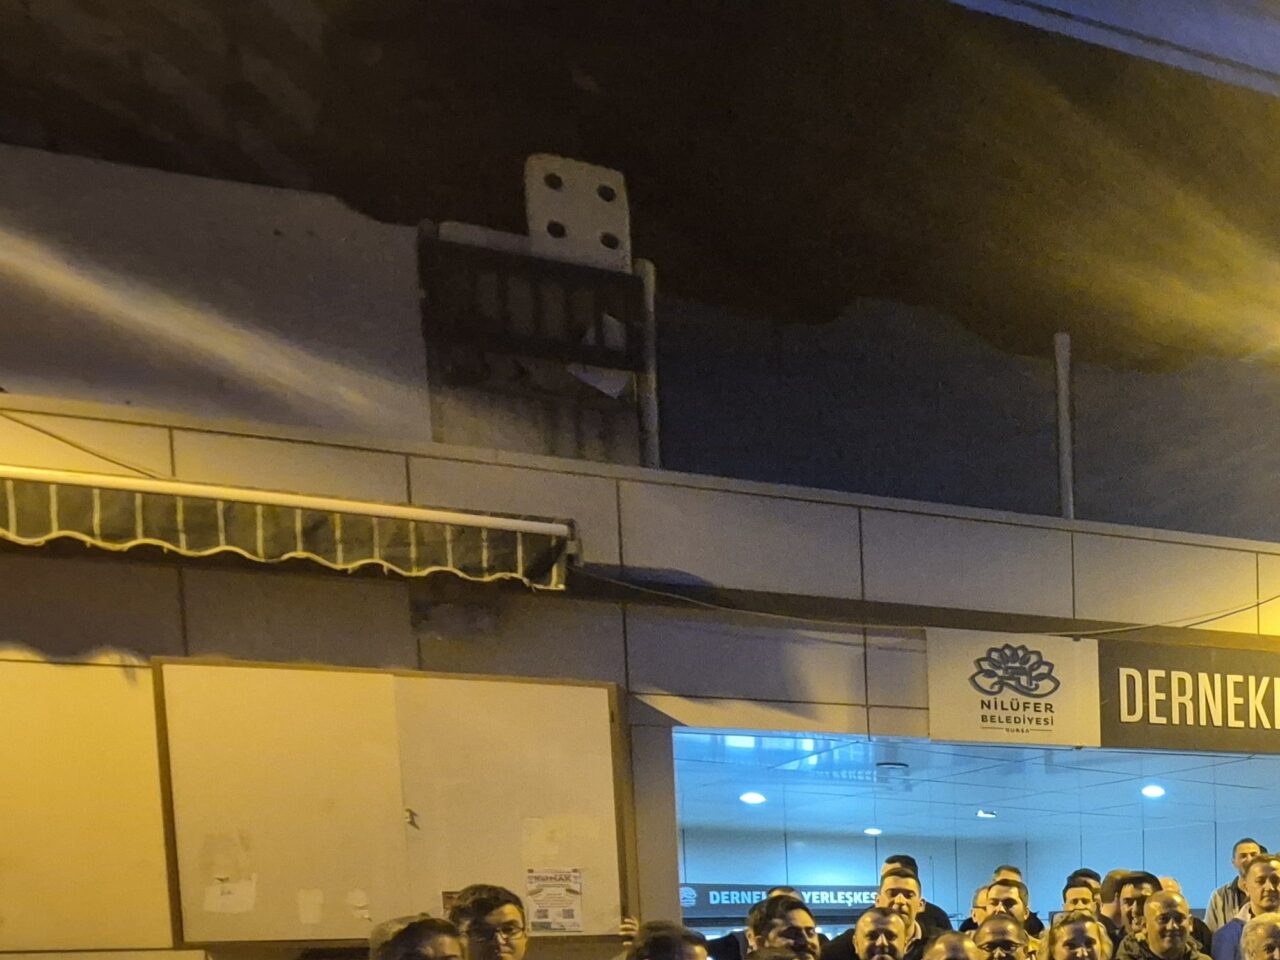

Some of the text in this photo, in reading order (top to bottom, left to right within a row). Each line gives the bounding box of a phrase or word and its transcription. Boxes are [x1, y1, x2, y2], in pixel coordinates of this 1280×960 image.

[980, 697, 1055, 714] NİLÜFER
[981, 714, 1054, 726] BELEDİYESİ
[709, 890, 877, 907] DERNE YERLEŞKES
